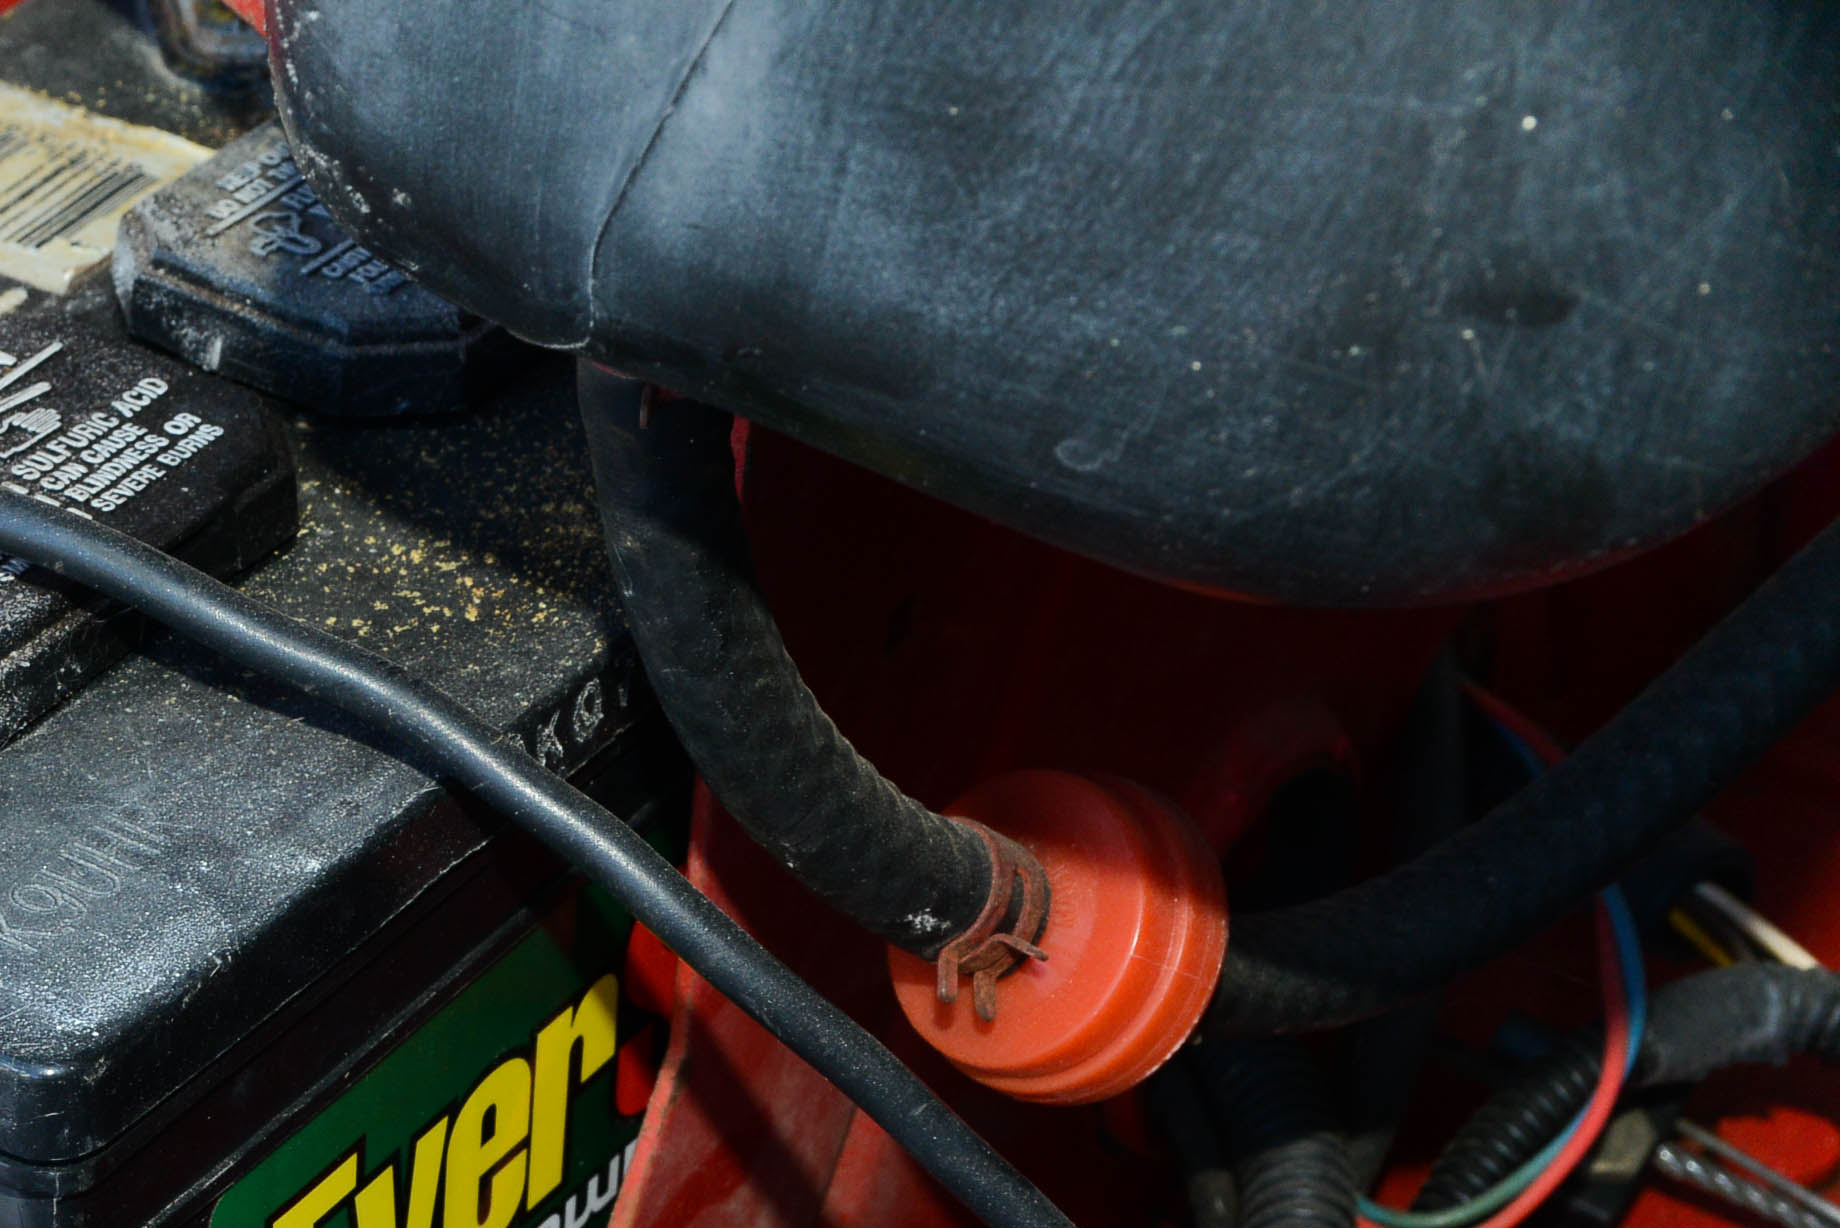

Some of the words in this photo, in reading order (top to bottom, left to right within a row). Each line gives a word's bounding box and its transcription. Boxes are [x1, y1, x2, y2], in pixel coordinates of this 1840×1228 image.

[11, 412, 119, 480] SULFURIC
[112, 377, 168, 418] ACID
[40, 462, 88, 490] CAN
[80, 422, 148, 464] CAUSE
[64, 433, 170, 502] BLINDNESS
[163, 412, 202, 435] OR
[90, 463, 167, 512] SEVERE
[156, 423, 224, 467] BURNS
